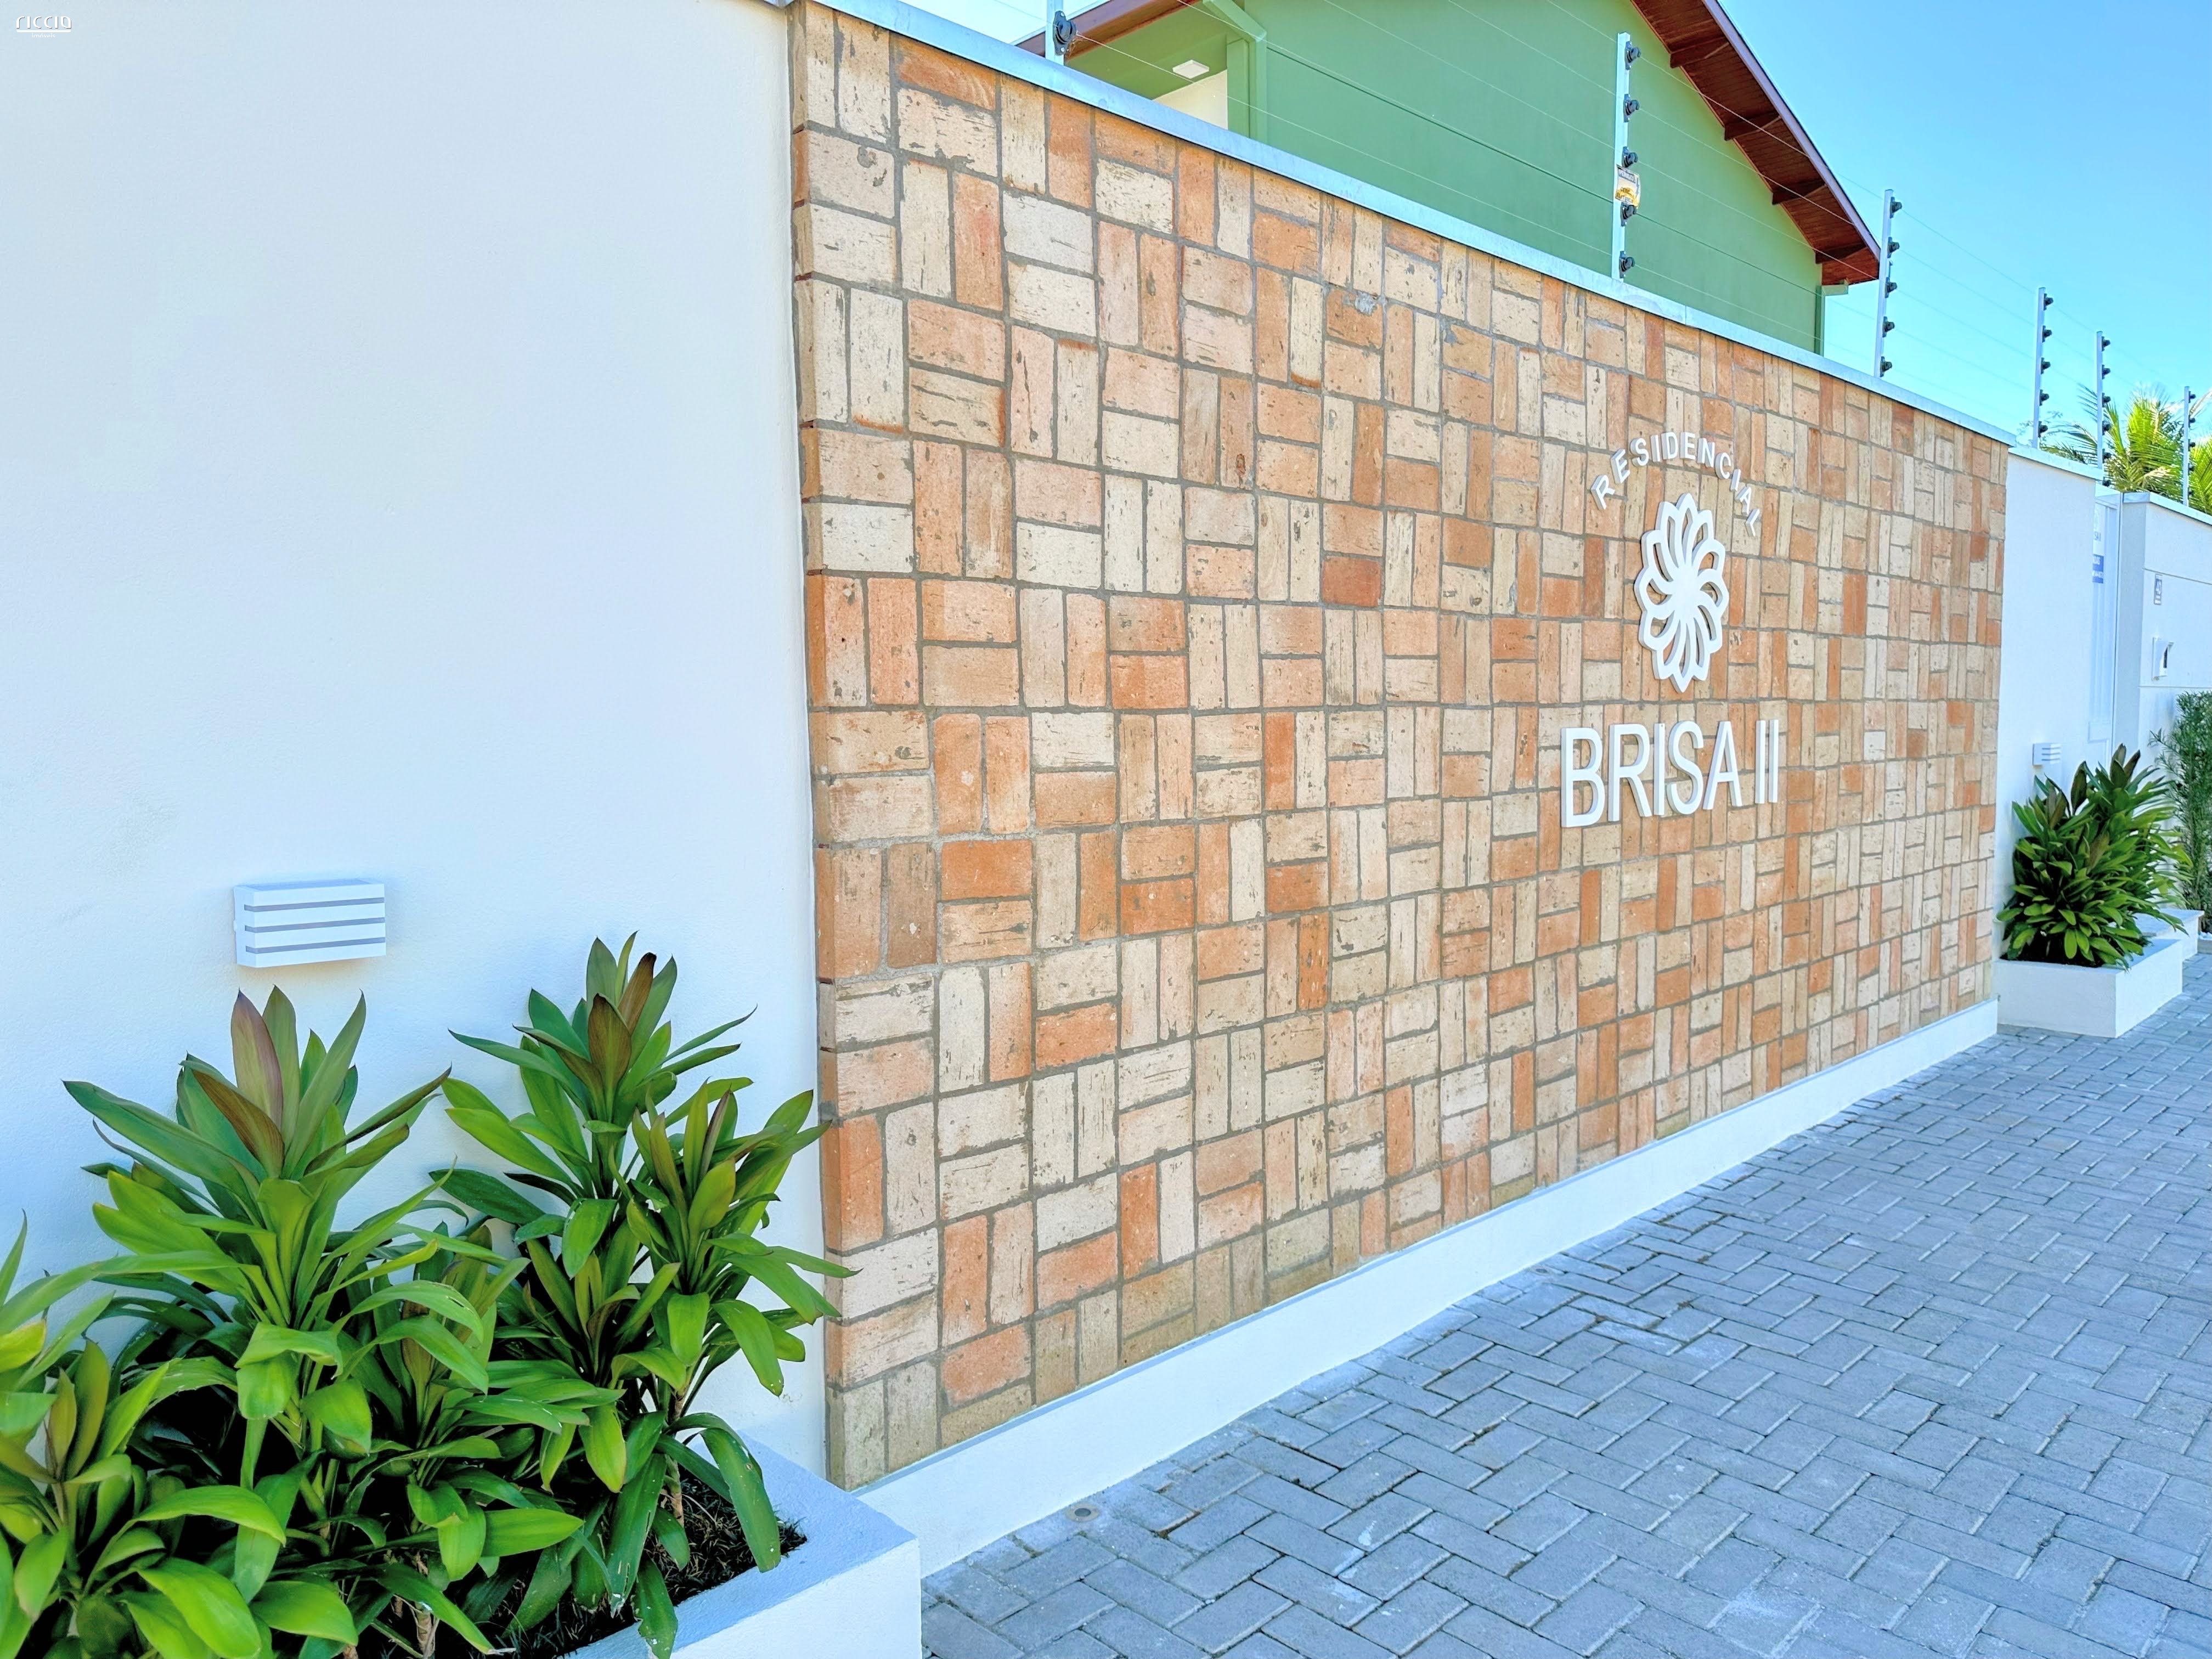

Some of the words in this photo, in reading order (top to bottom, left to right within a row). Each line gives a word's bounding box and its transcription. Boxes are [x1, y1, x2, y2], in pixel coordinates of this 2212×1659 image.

[1590, 431, 1760, 537] RESIDENCIAL
[1561, 720, 1743, 828] BRISA
[1755, 719, 1779, 804] II
